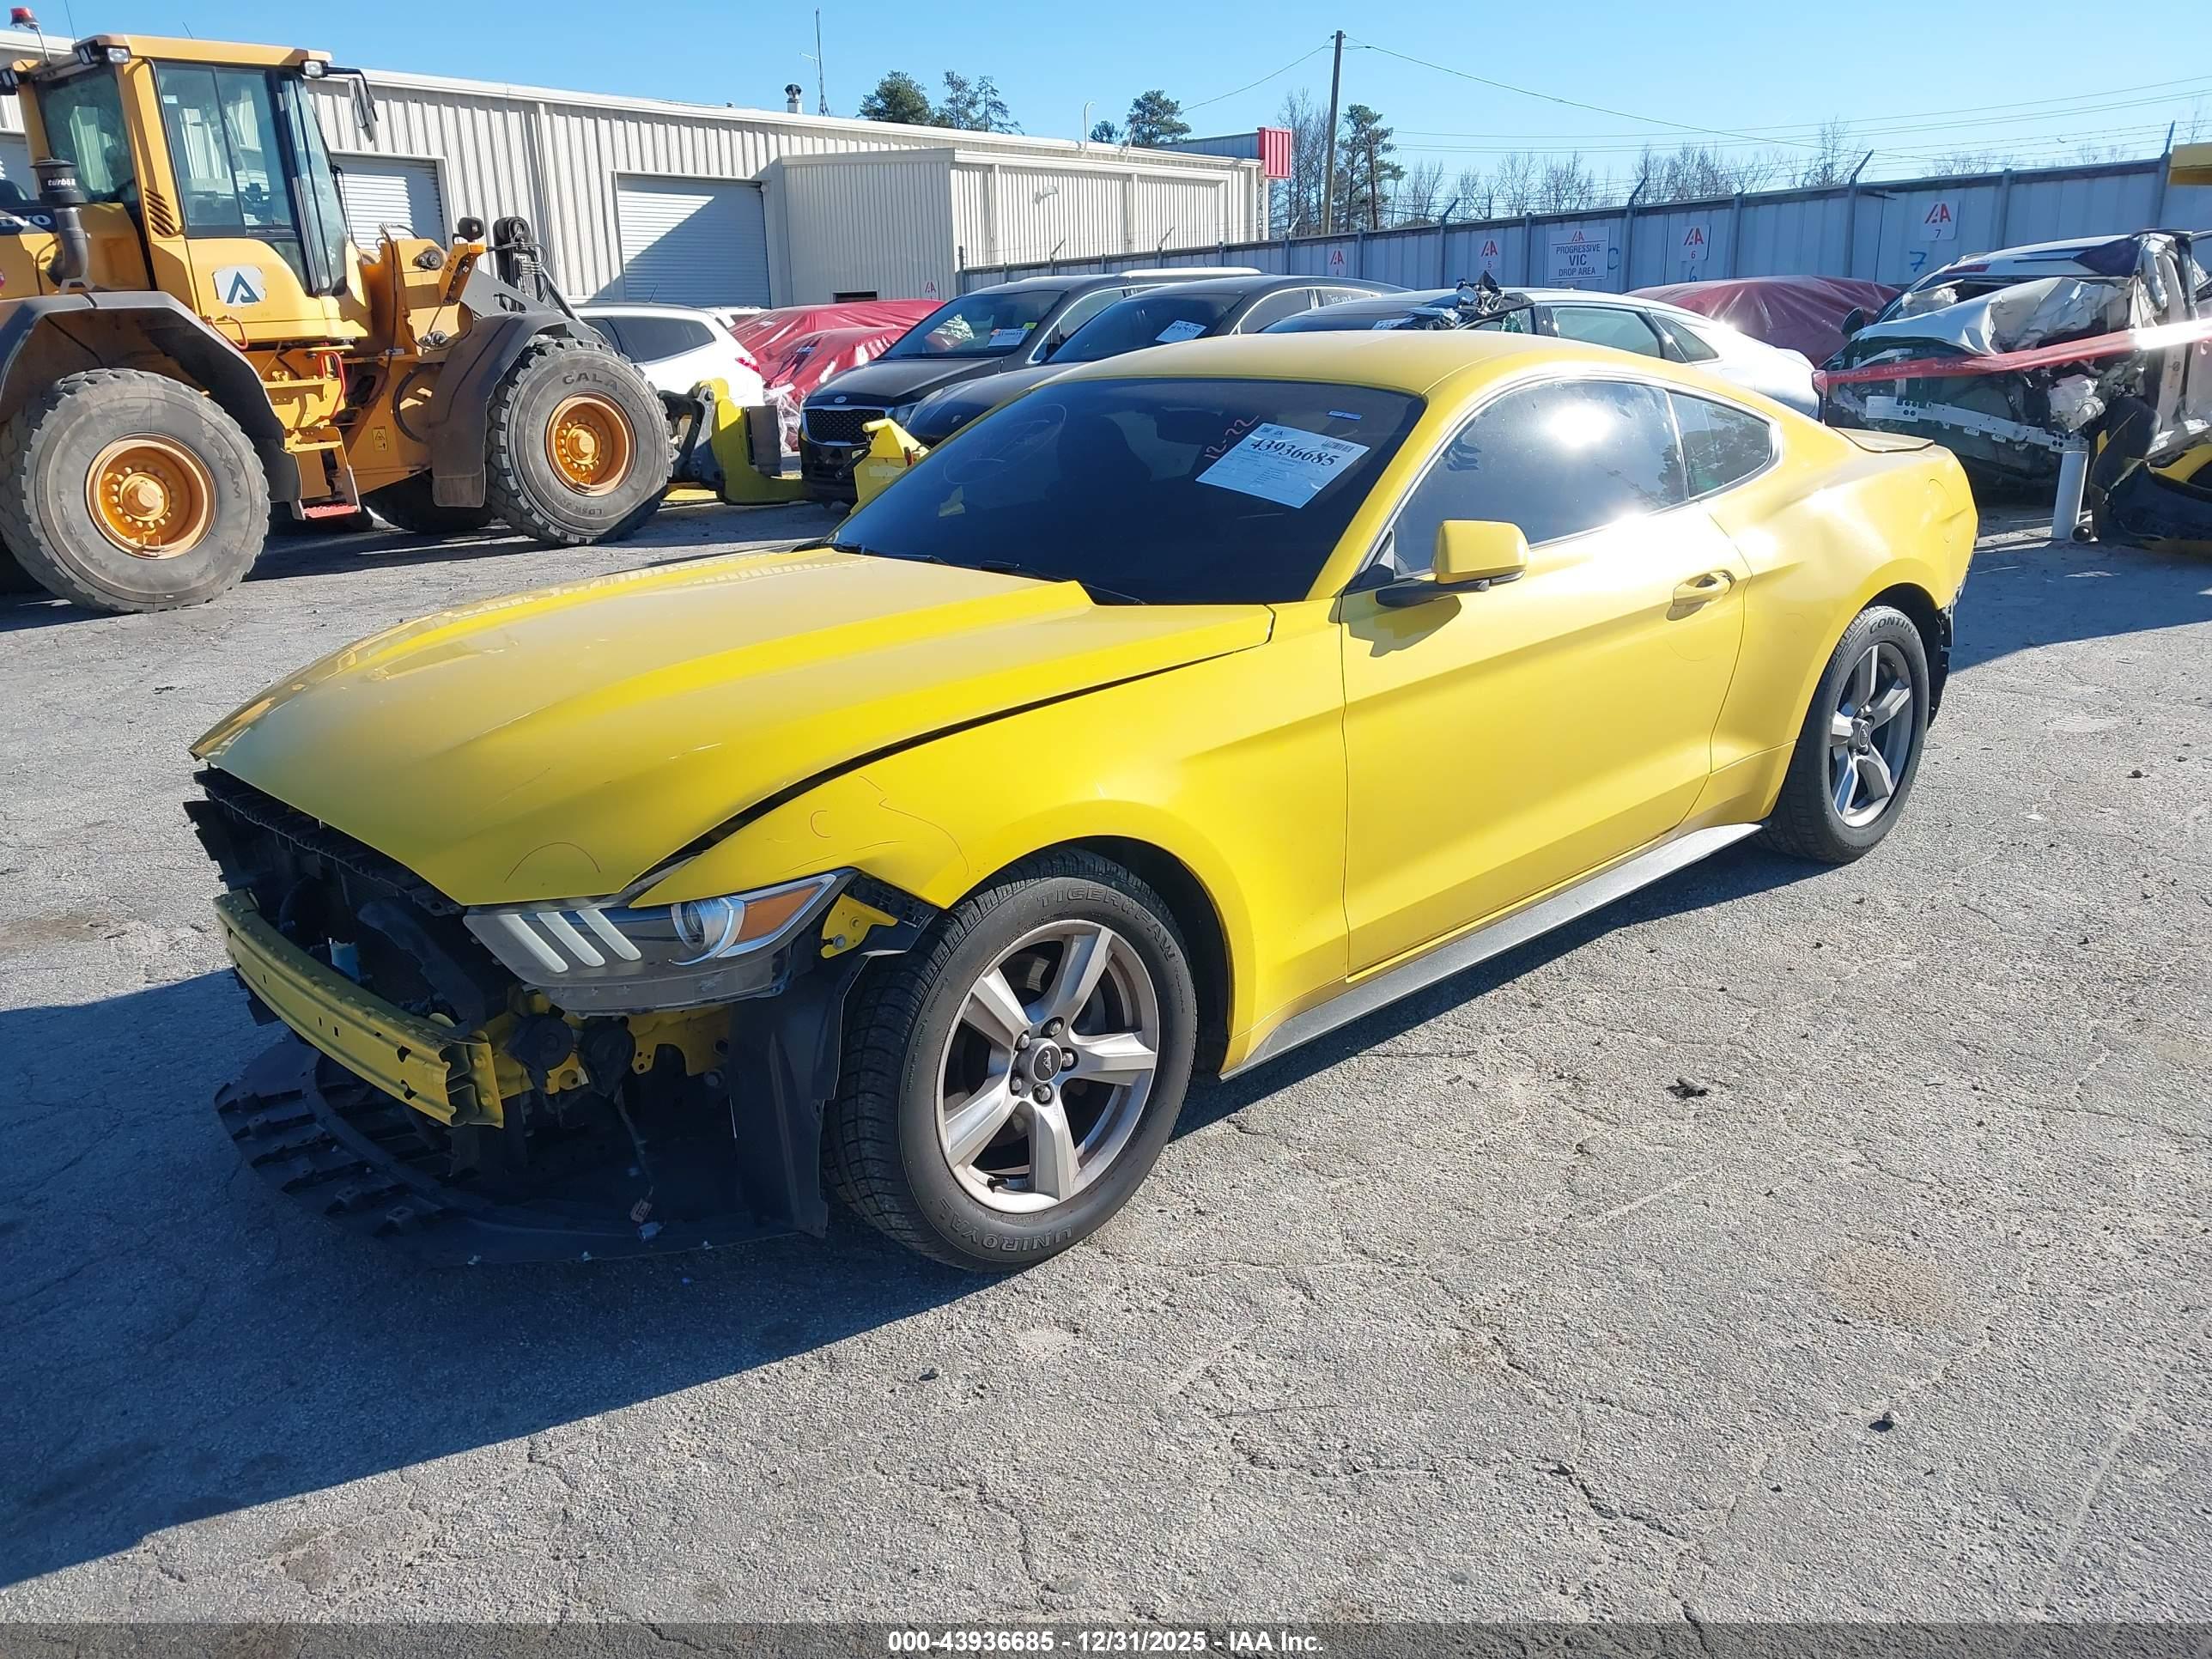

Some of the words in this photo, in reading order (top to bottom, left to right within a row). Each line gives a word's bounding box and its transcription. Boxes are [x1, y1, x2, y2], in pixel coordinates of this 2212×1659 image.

[1935, 228, 1942, 238] 7
[1556, 244, 1601, 254] PROGRESSIVE
[1691, 250, 1697, 259] 6
[1487, 260, 1493, 269] 5
[1569, 253, 1587, 266] VIC
[1909, 251, 1927, 273] 7
[1559, 268, 1577, 276] DROP
[1578, 266, 1595, 276] AREA
[1250, 438, 1341, 467] 43936685
[1036, 885, 1121, 908] TIGER
[1134, 904, 1176, 963] PAW
